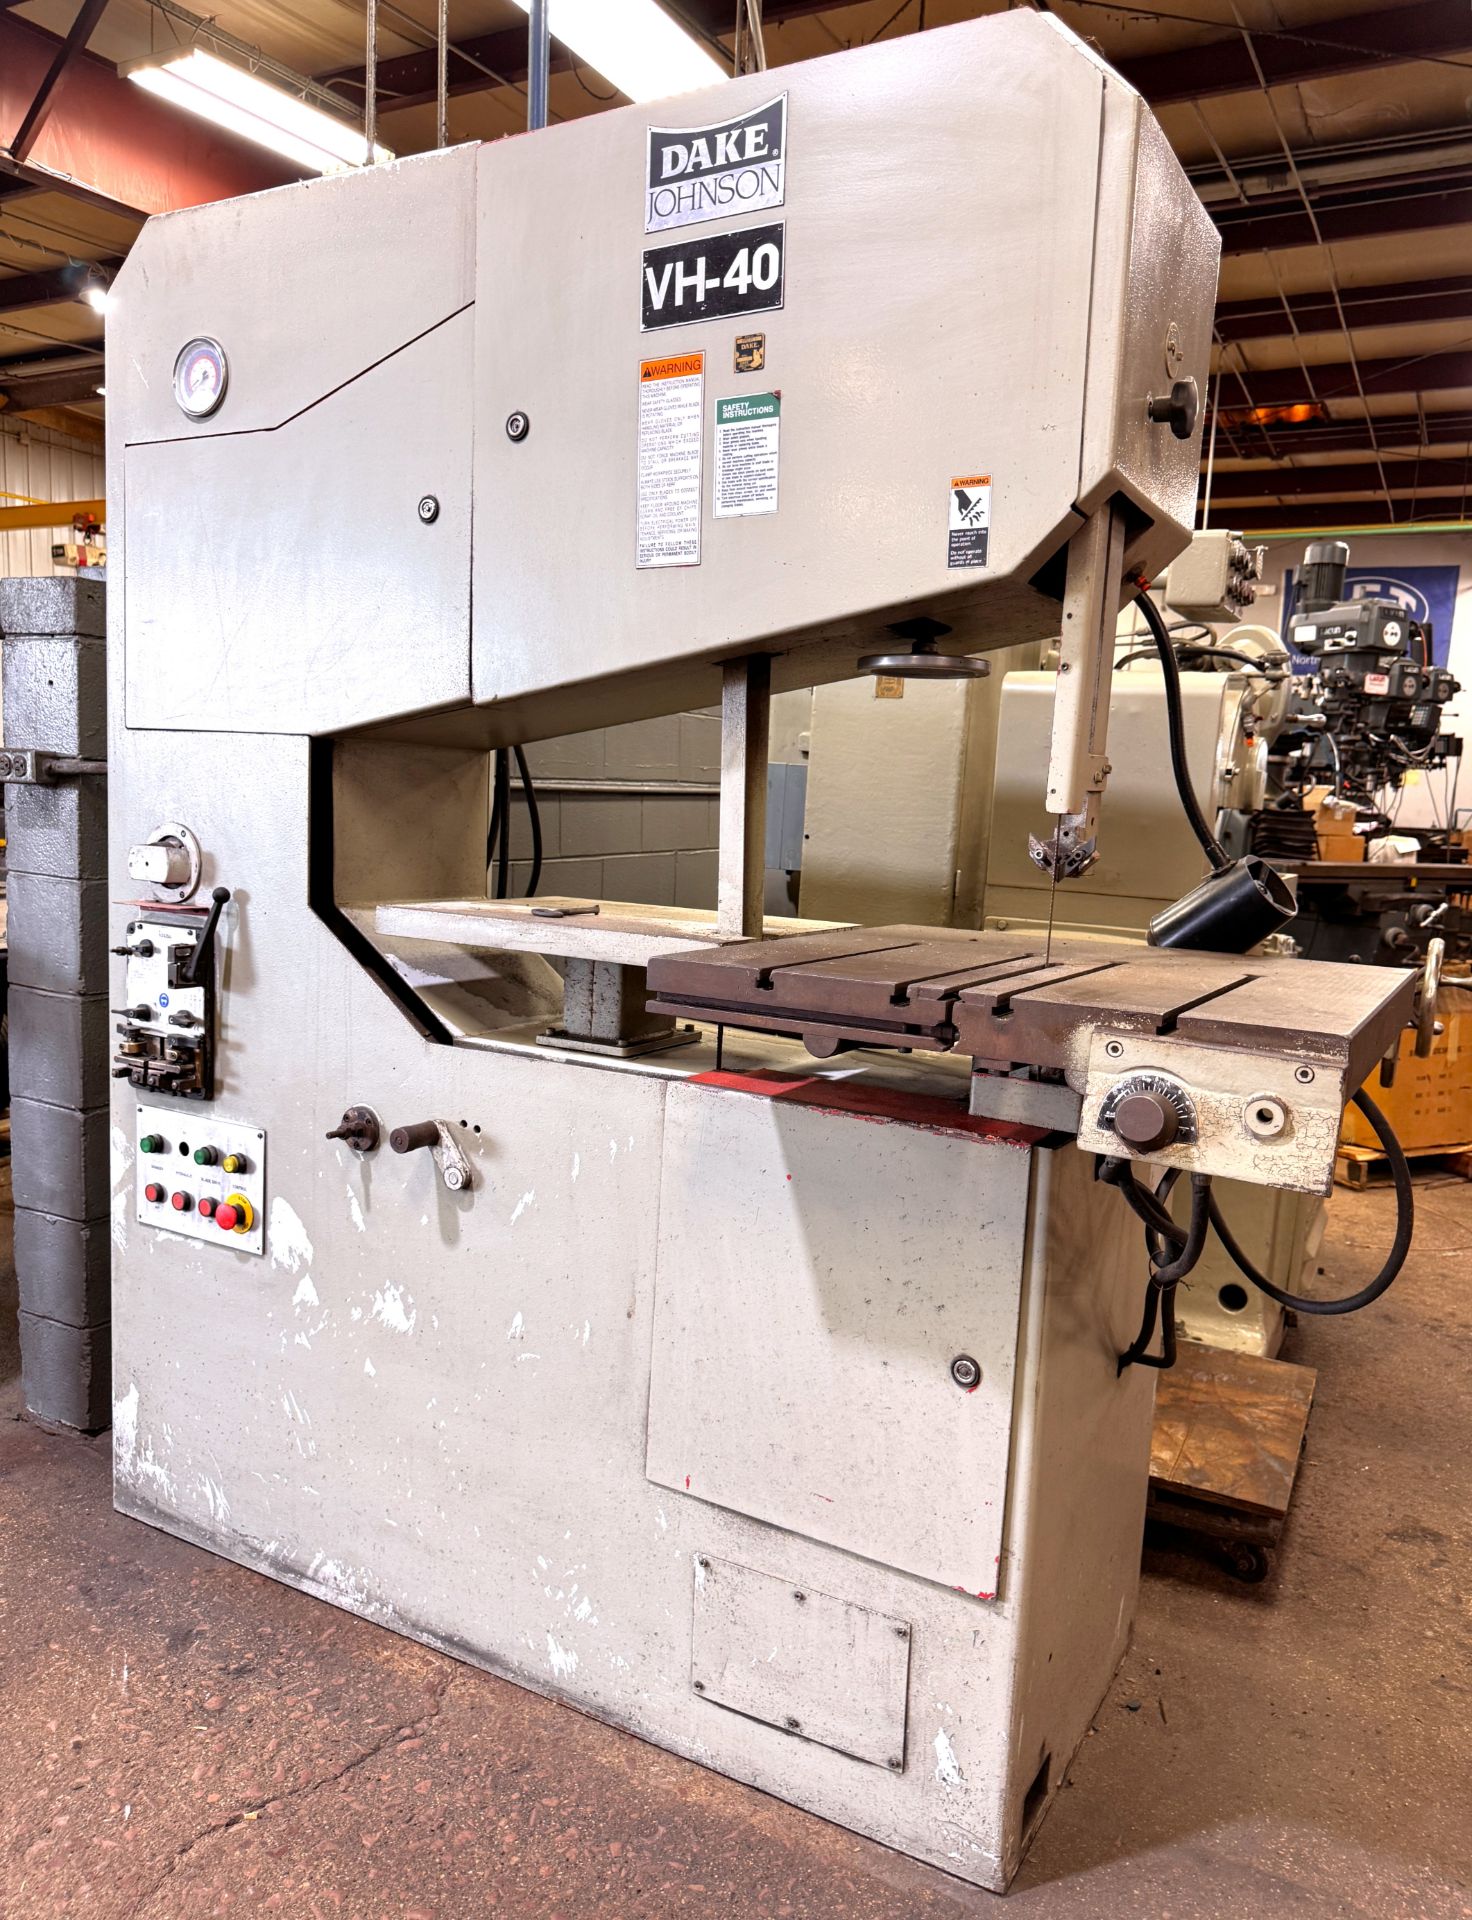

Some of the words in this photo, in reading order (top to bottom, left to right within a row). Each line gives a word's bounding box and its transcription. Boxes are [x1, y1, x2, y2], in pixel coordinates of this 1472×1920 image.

[660, 123, 769, 179] DAKE
[648, 164, 782, 224] JOHNSON
[644, 242, 780, 311] VH-40
[651, 360, 701, 376] WARNING
[723, 402, 749, 412] SAFETY
[723, 405, 774, 418] INSTRUCTIONS
[960, 478, 988, 486] WARNING
